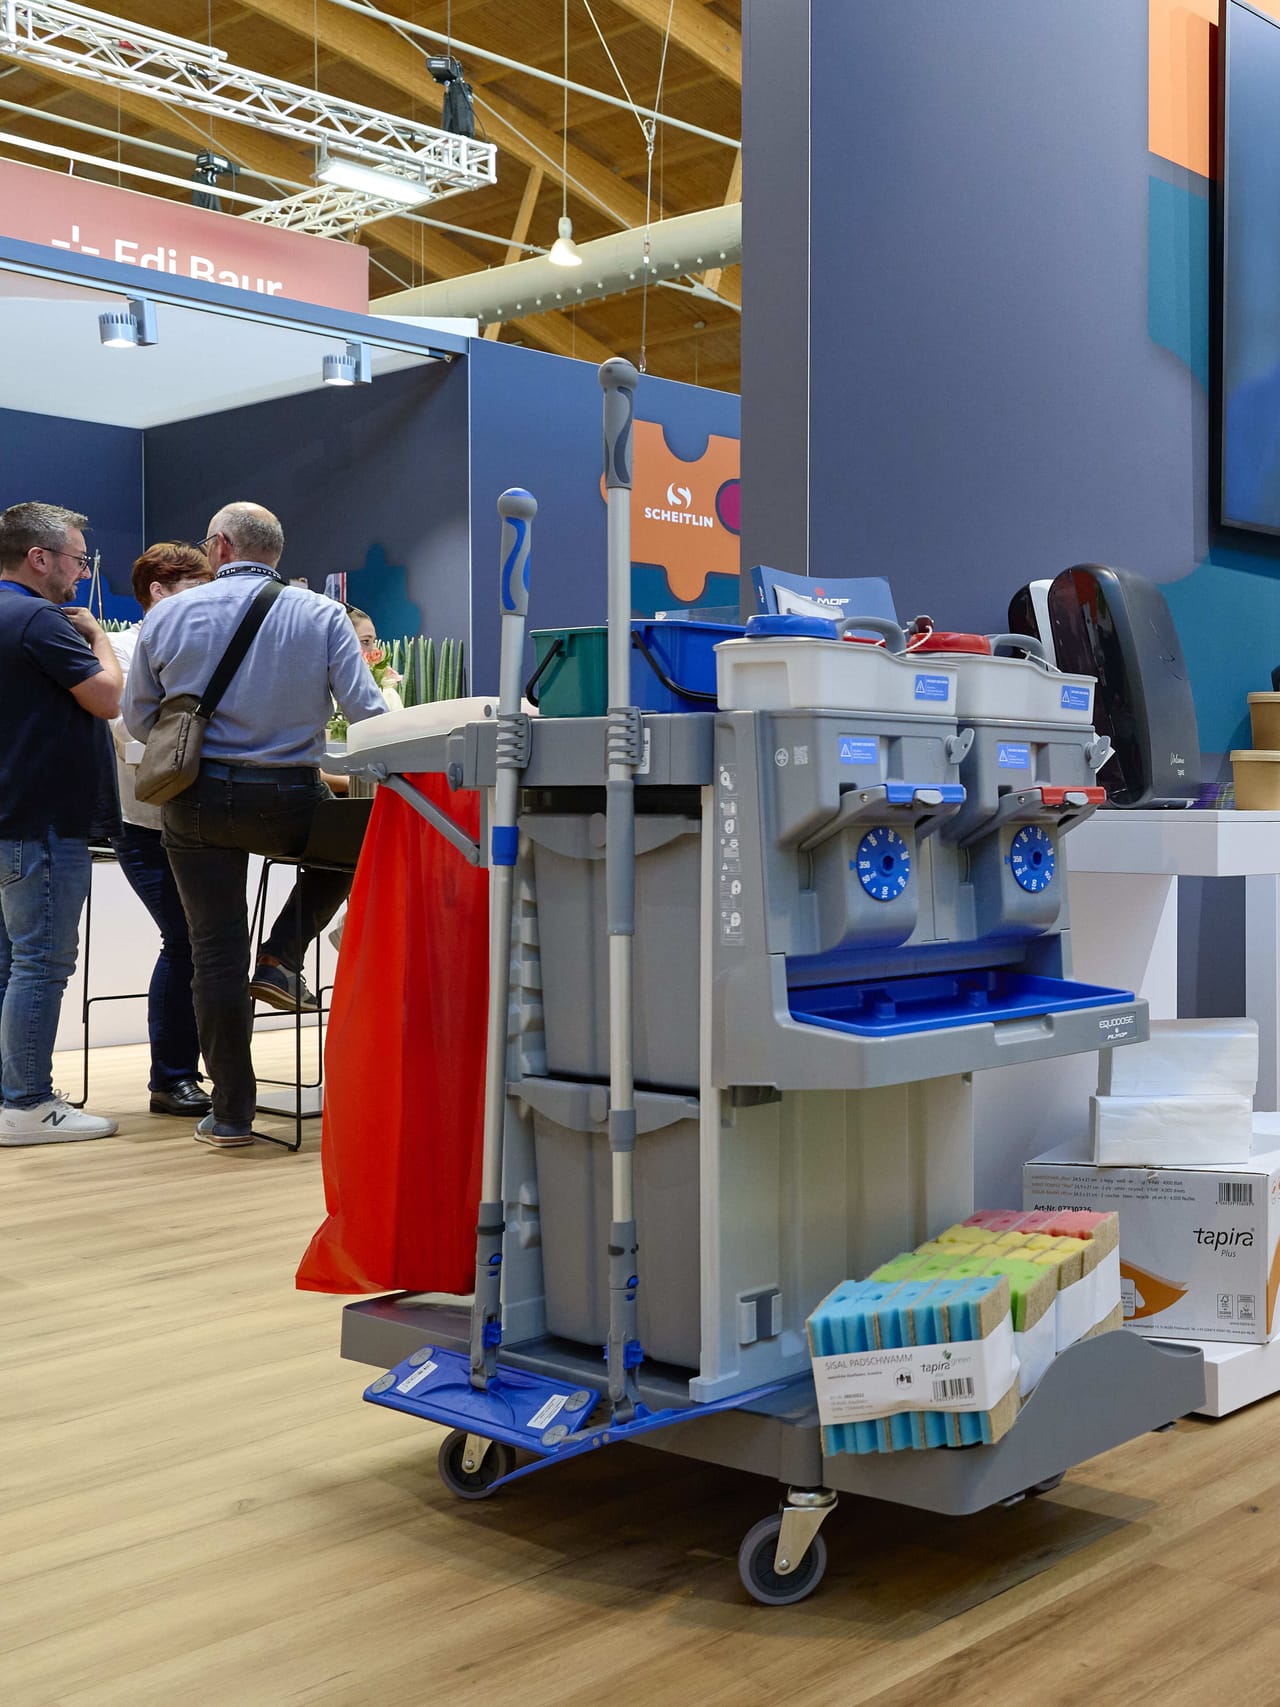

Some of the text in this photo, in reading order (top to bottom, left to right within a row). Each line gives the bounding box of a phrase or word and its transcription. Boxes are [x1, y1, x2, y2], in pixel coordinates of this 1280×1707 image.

[644, 507, 713, 528] SCHEITLIN
[1221, 1250, 1236, 1258] Plus
[825, 1354, 913, 1370] SISAL PADSCHWAMM
